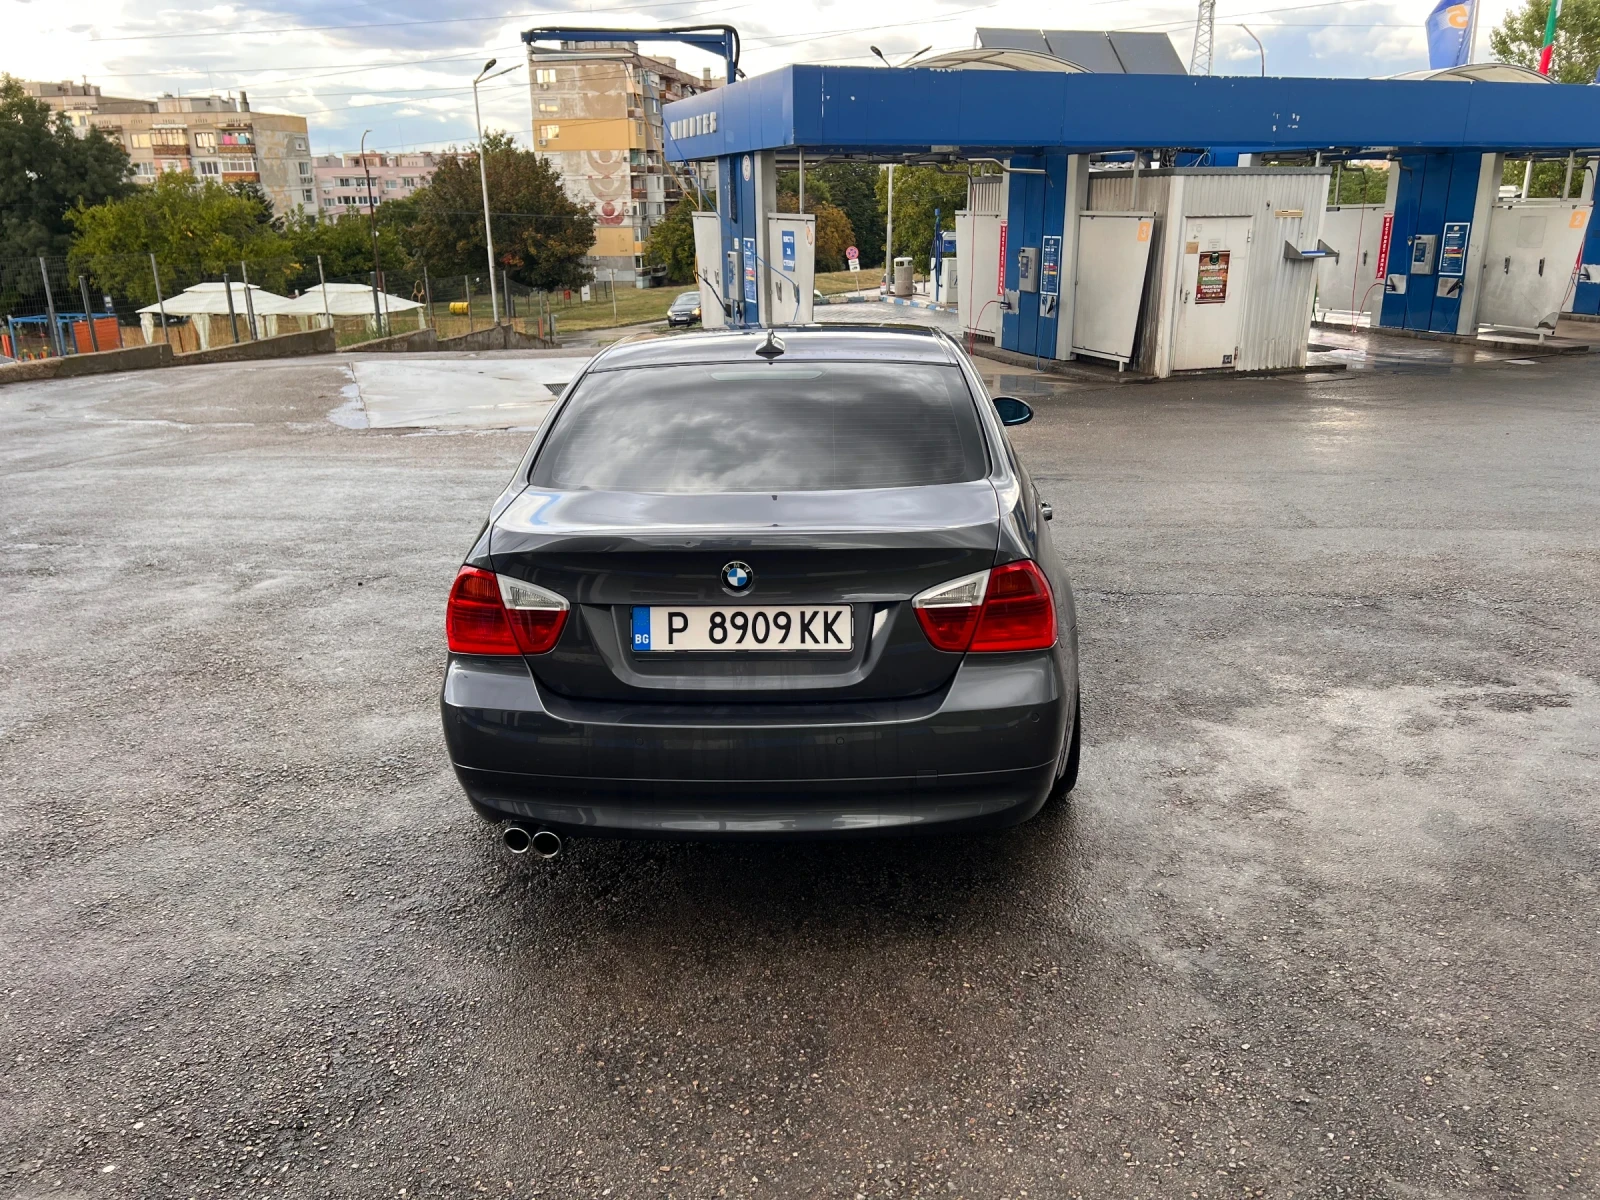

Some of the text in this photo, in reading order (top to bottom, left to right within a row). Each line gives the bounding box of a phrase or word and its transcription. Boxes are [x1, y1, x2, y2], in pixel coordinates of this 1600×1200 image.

[1573, 215, 1582, 226] 2
[667, 611, 689, 644] P
[635, 634, 649, 644] BG
